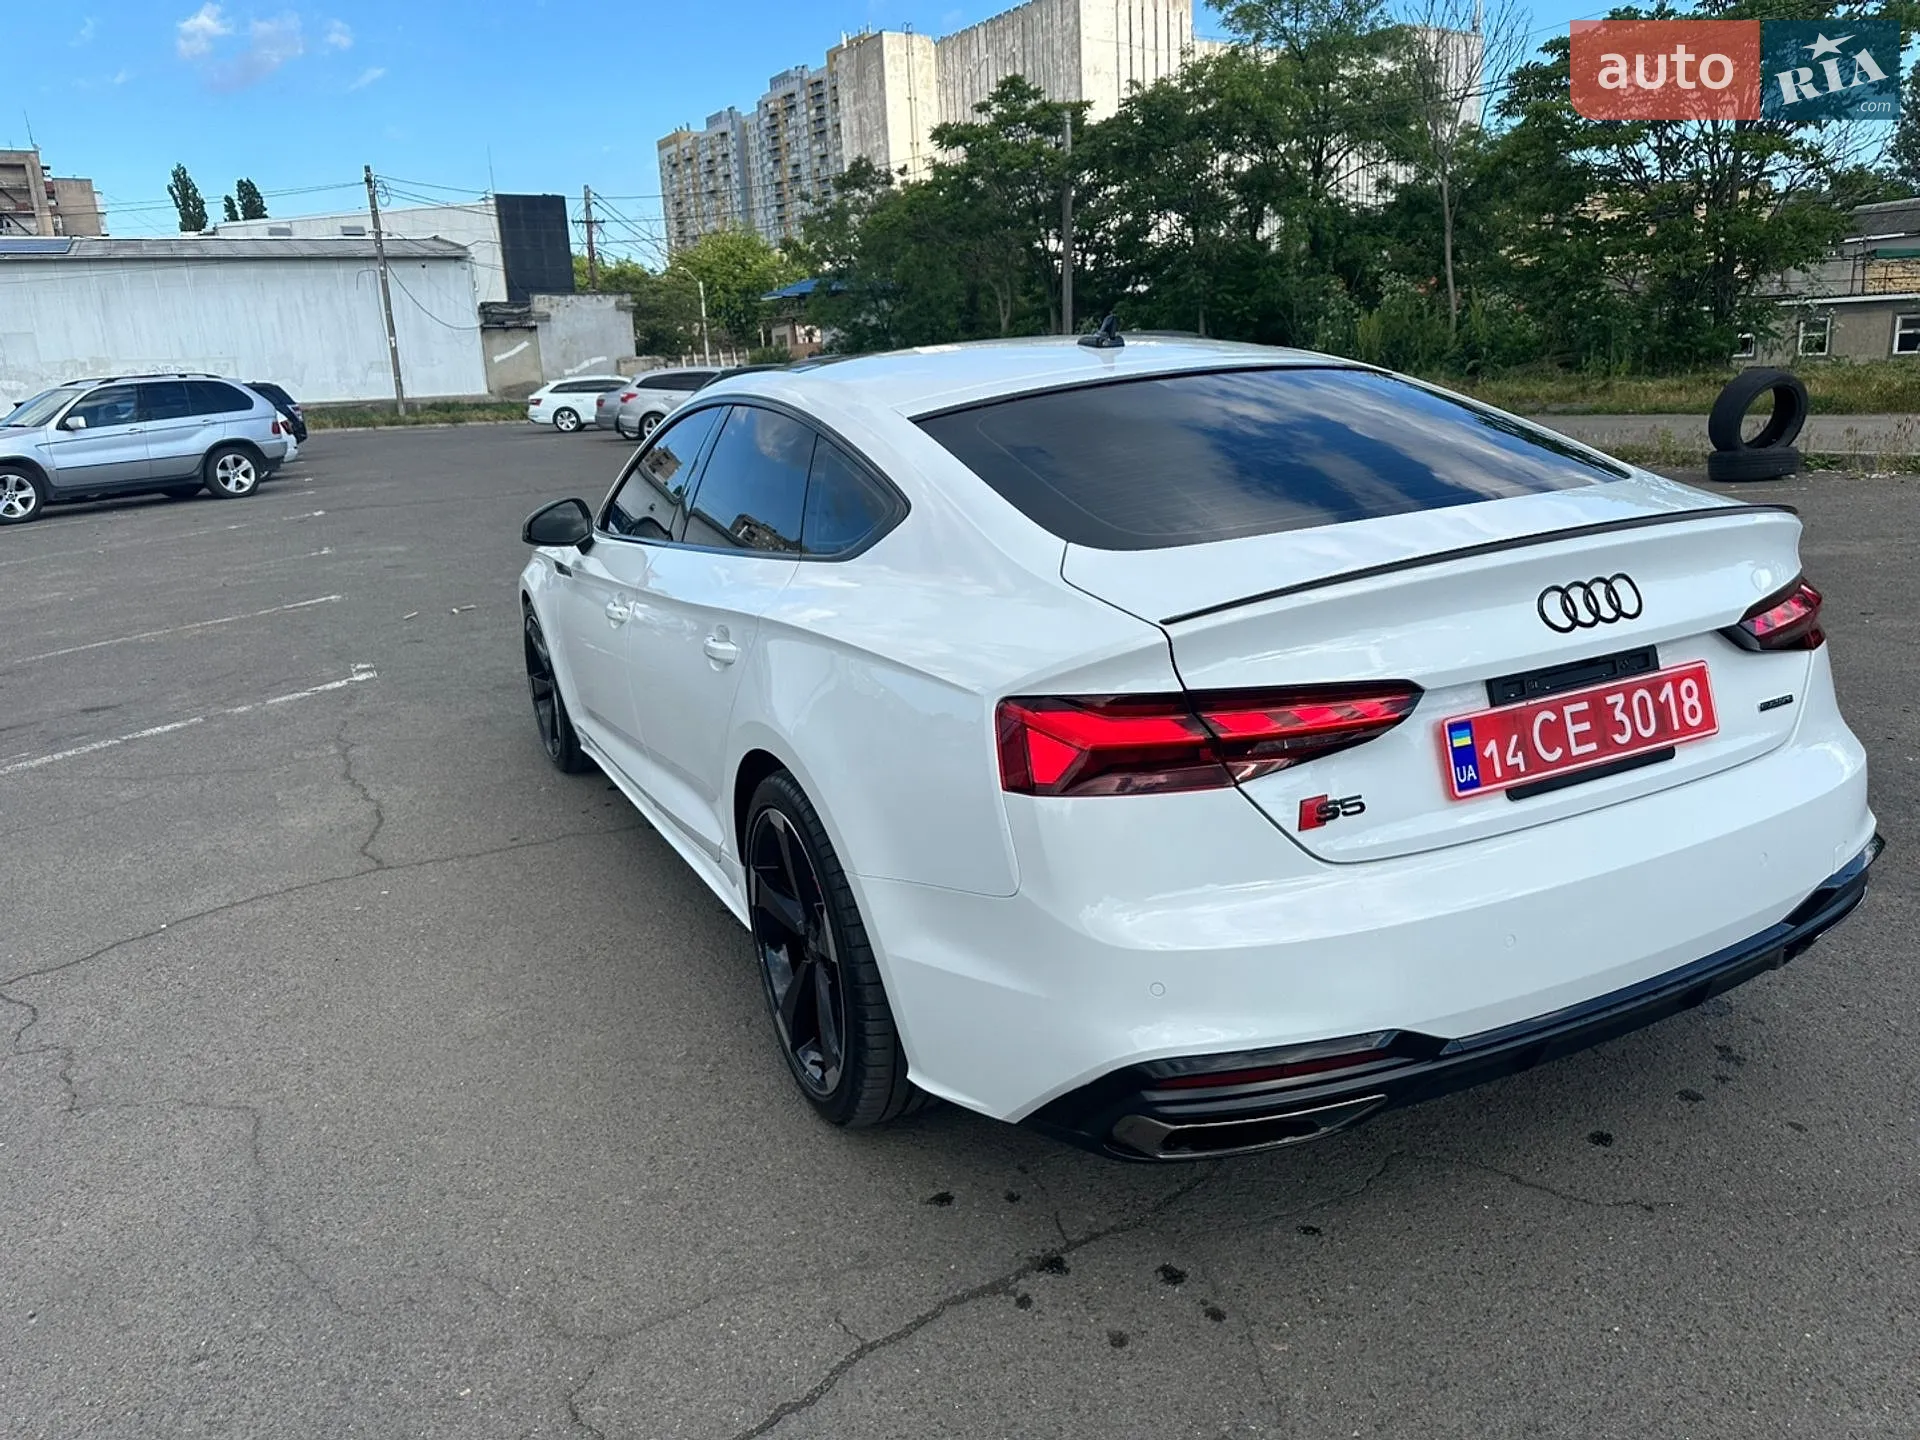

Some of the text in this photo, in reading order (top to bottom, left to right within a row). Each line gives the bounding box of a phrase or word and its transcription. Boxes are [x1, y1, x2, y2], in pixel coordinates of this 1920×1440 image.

[1483, 678, 1703, 778] 14 CE 3018
[1456, 765, 1477, 783] UA
[1315, 794, 1366, 823] S5
